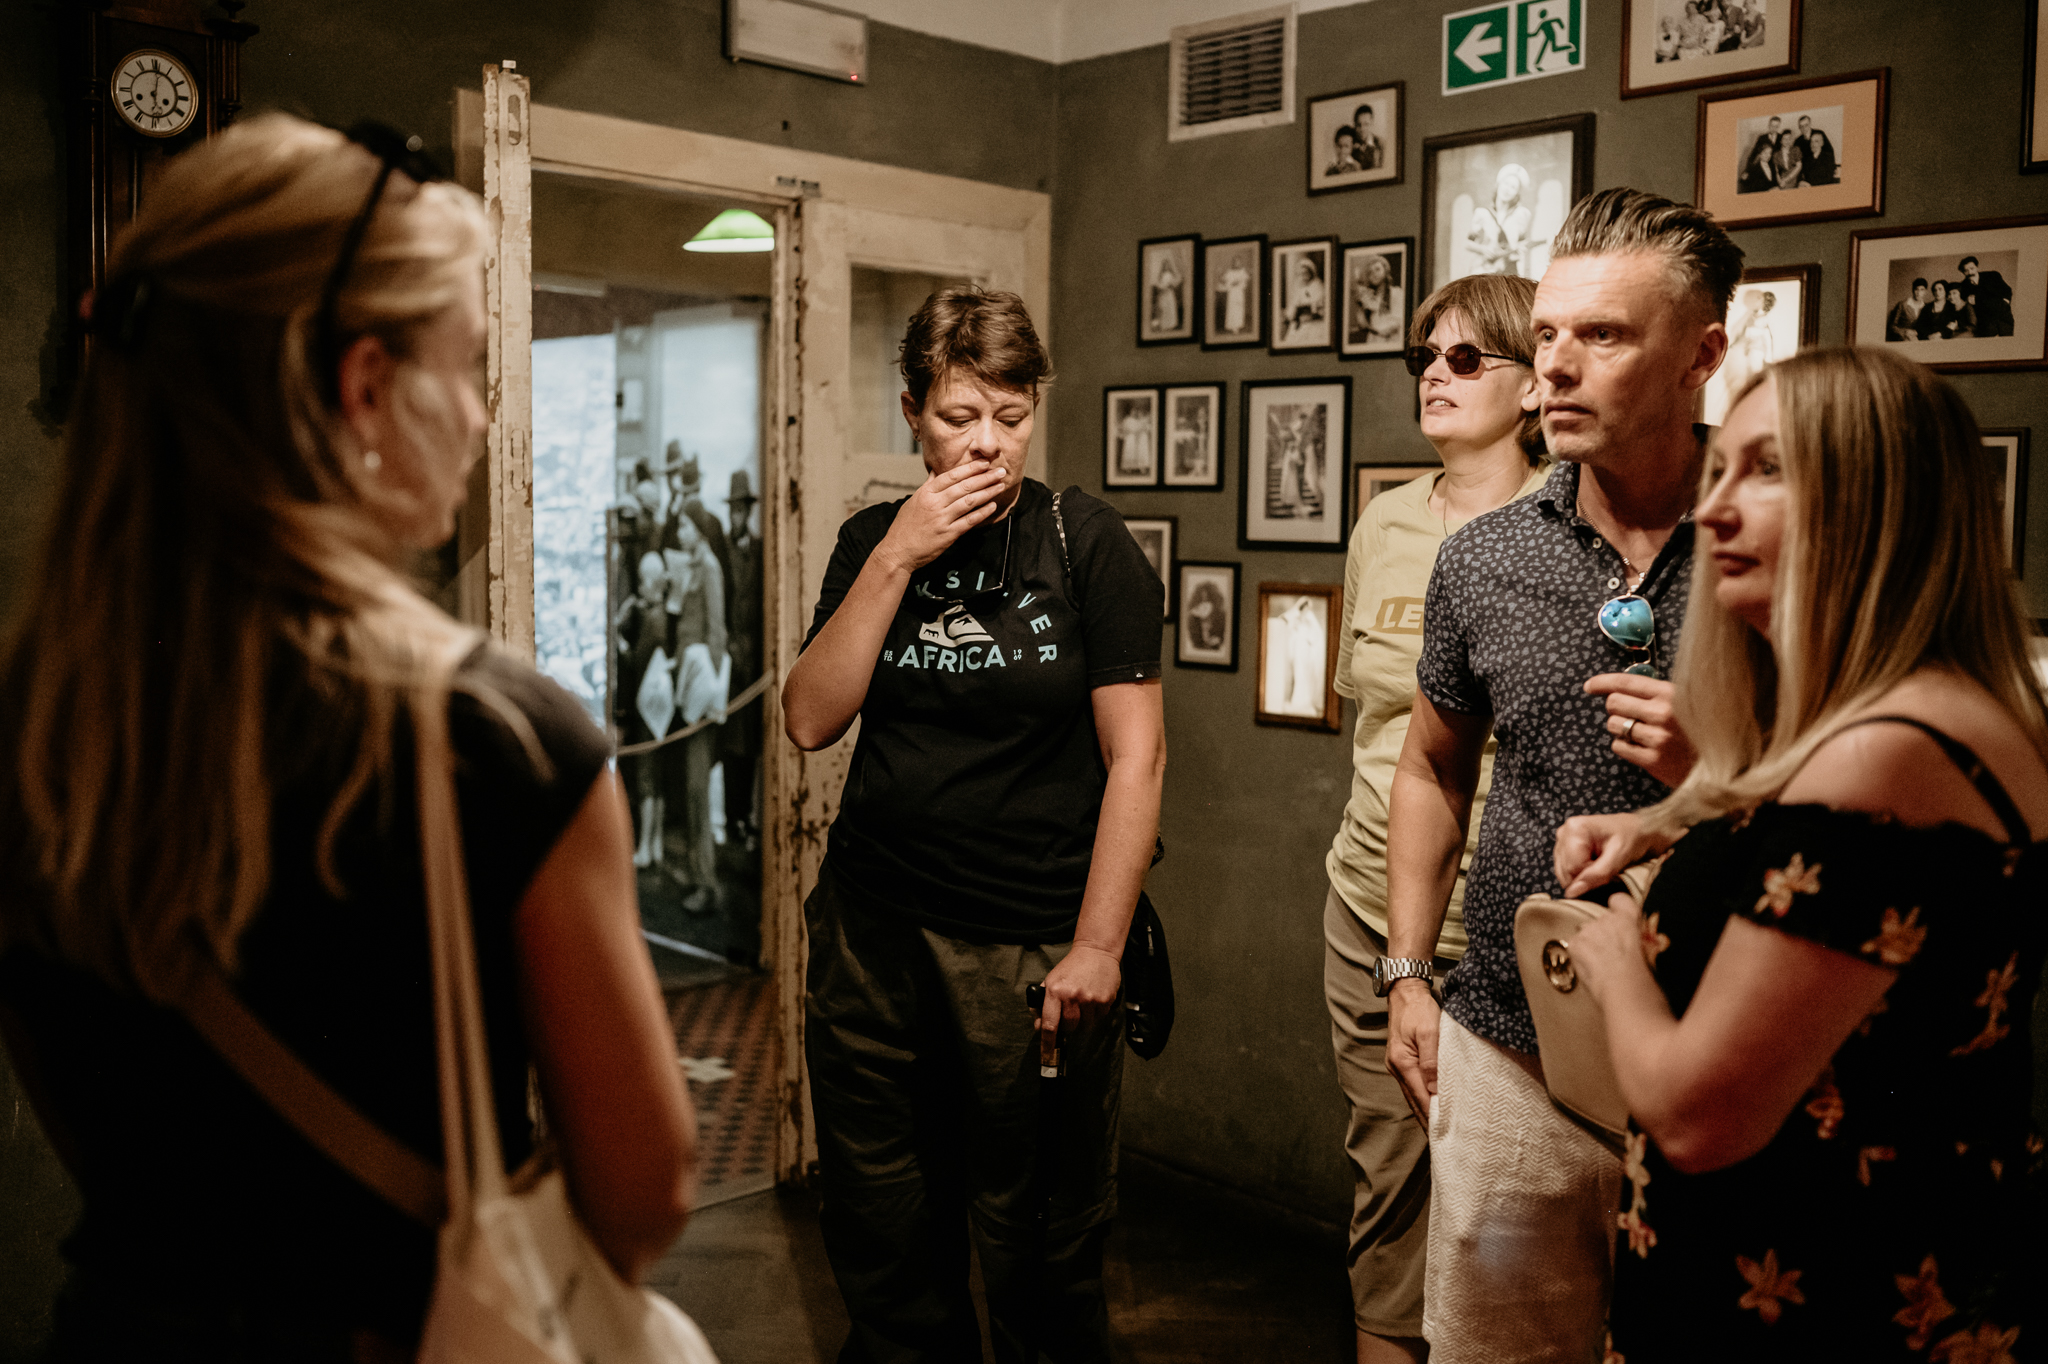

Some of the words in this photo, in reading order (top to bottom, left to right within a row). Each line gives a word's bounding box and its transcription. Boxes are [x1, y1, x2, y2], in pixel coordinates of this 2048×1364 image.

[914, 569, 1058, 664] KSIVER
[1382, 603, 1424, 629] LE
[897, 644, 1006, 673] AFRICA
